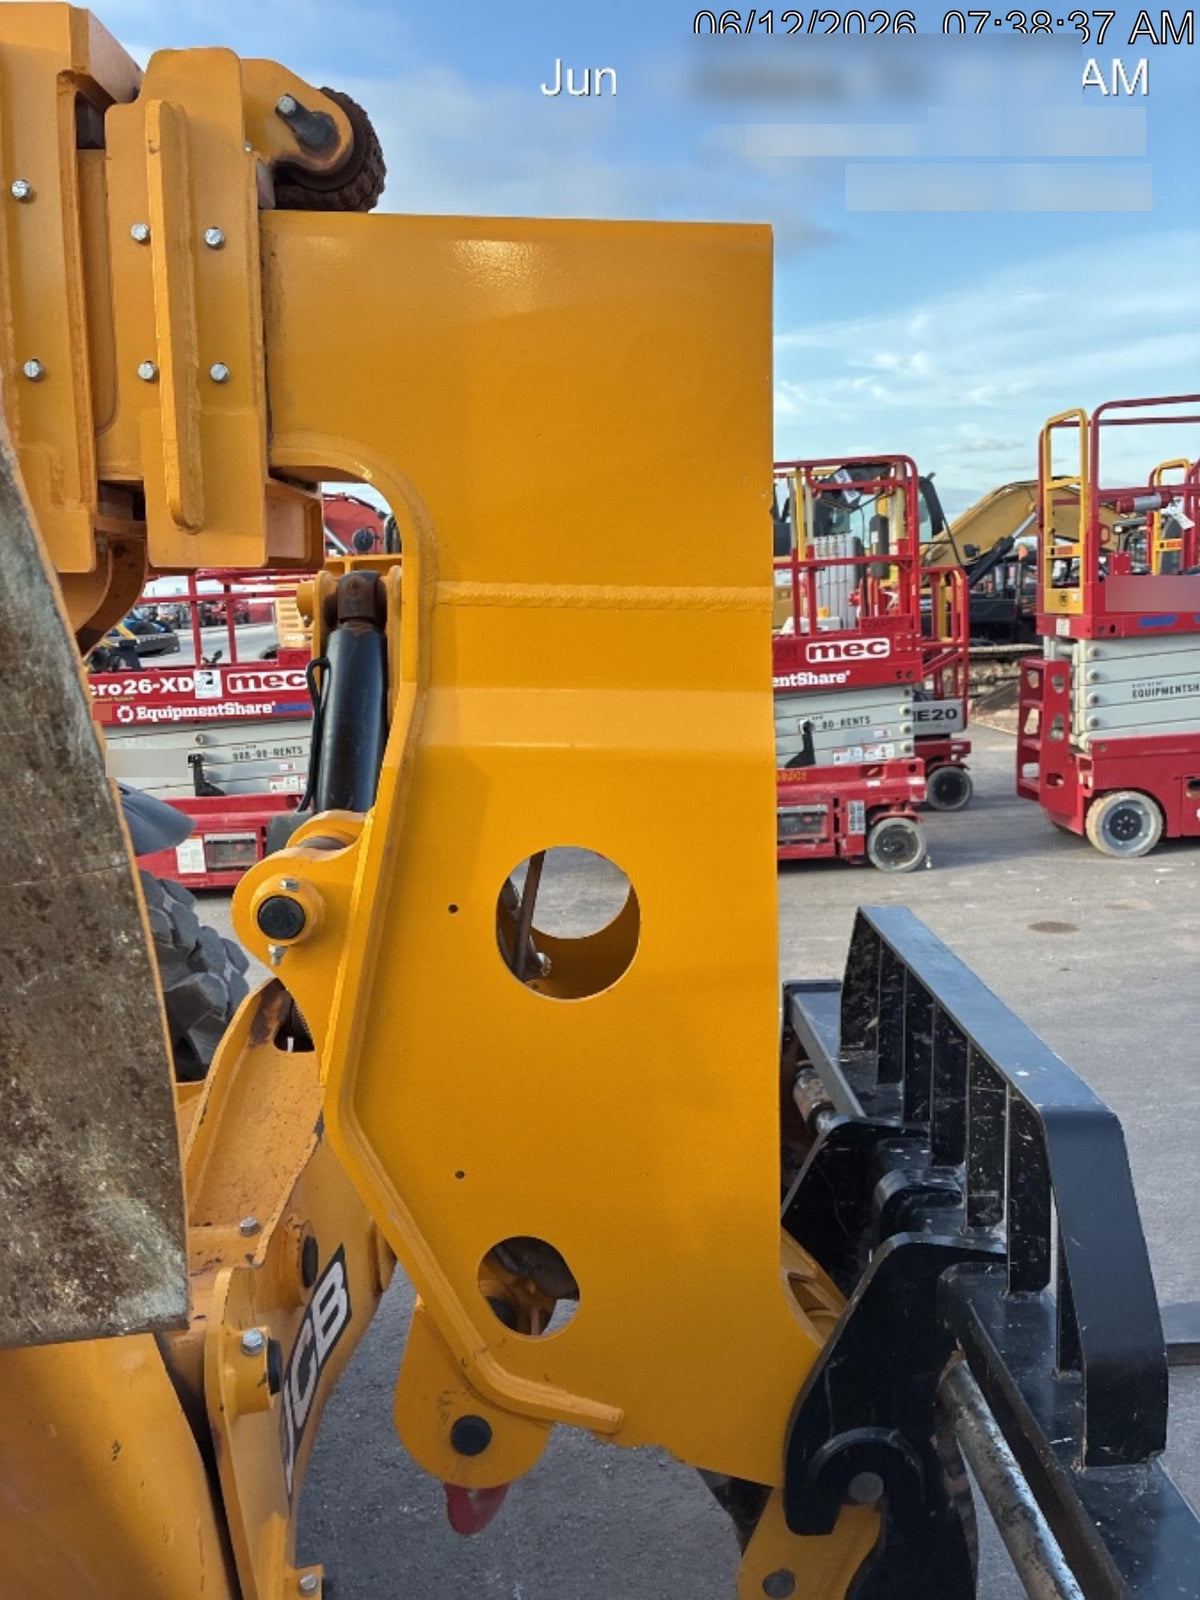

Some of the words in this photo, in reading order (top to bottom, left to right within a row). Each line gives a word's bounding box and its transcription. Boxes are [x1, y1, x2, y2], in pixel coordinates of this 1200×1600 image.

[808, 640, 889, 661] mec
[229, 671, 307, 691] mec
[136, 702, 274, 722] EquipmentShare
[282, 1260, 348, 1497] JCB
